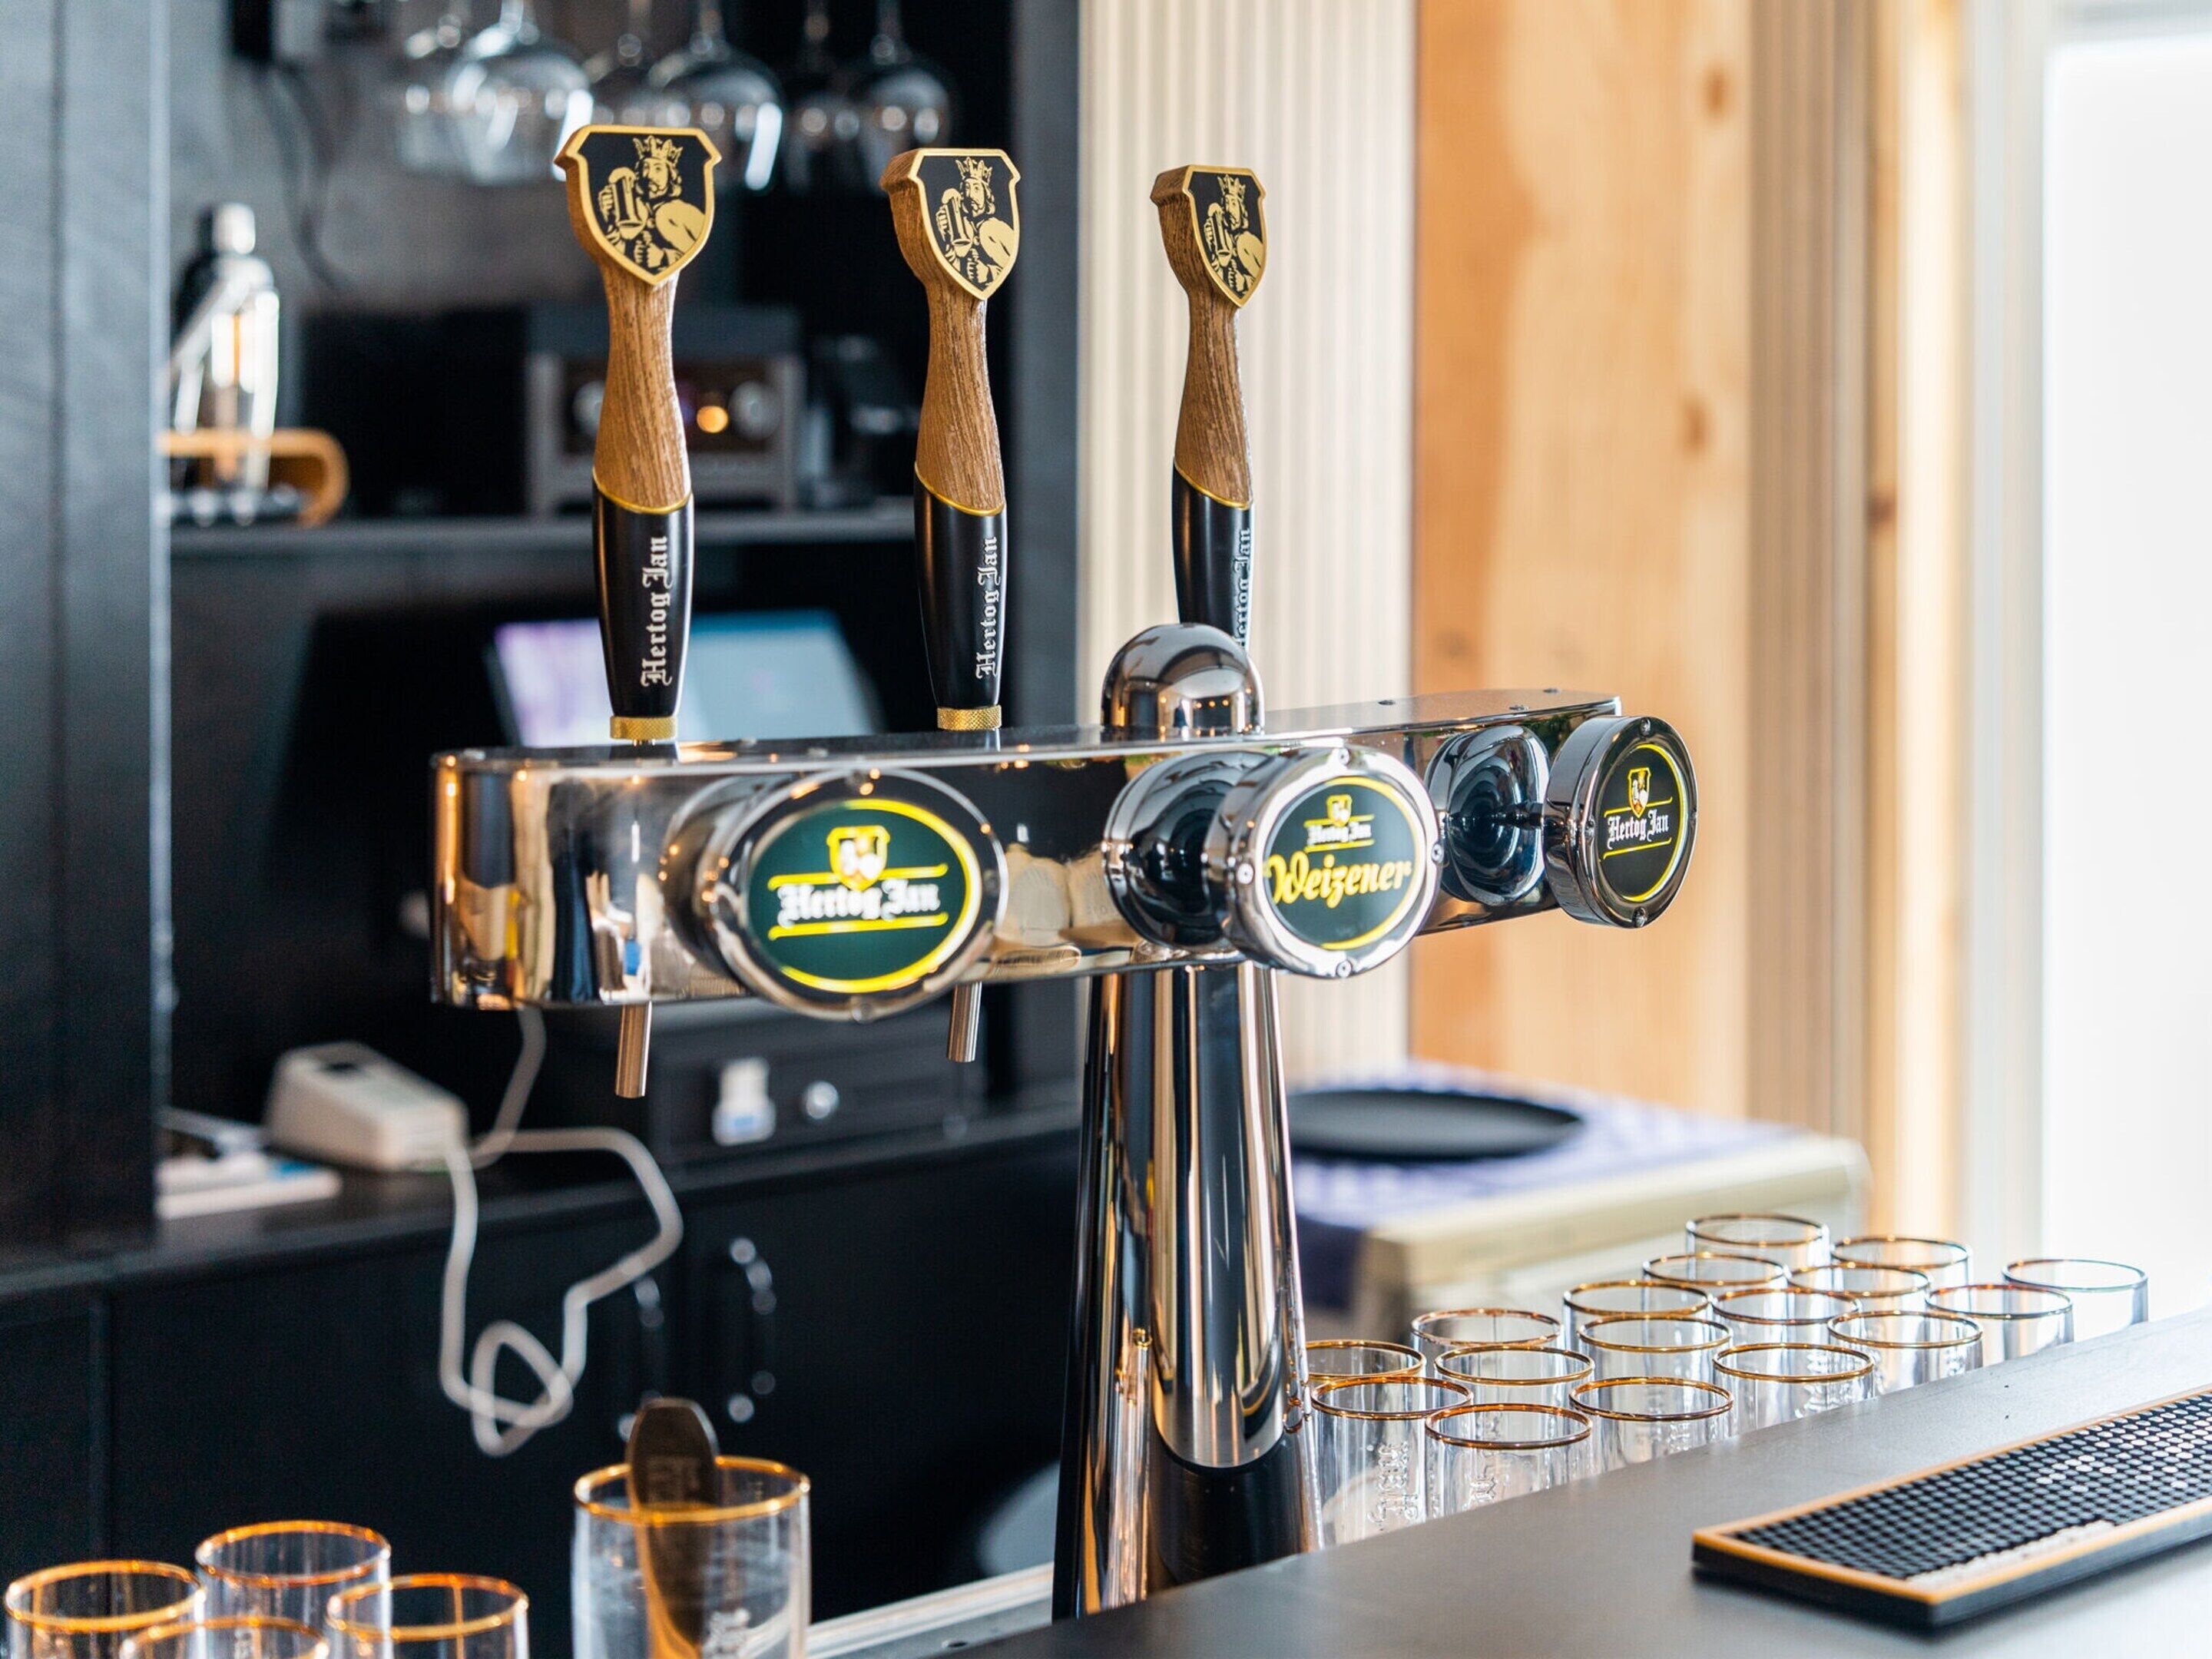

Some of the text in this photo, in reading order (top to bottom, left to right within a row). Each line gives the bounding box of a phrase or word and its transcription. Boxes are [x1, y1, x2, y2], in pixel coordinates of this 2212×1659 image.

[1233, 528, 1250, 575] Jan
[641, 535, 674, 687] Hertog Jan
[975, 536, 1002, 680] Hertog Jan
[1606, 808, 1670, 850] Hertog Jan
[777, 878, 941, 929] Hertog Jan
[1263, 850, 1413, 909] Weizener
